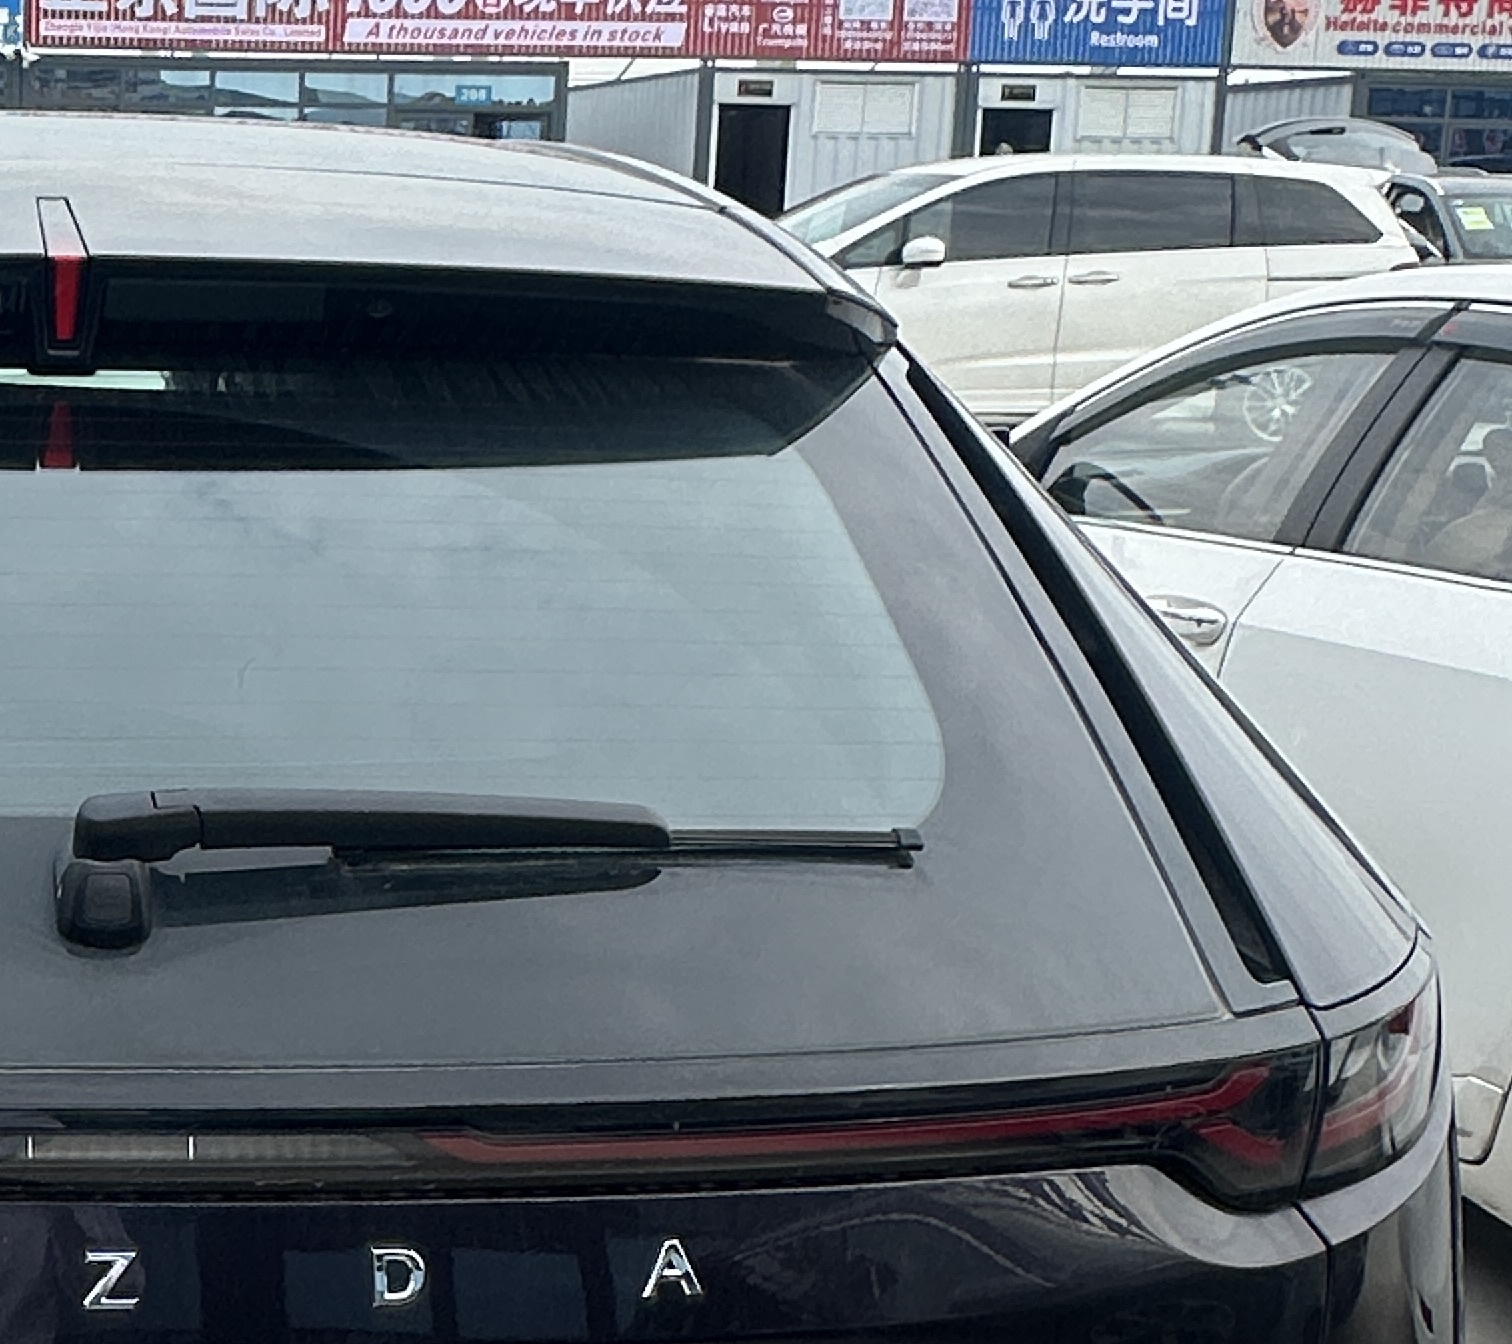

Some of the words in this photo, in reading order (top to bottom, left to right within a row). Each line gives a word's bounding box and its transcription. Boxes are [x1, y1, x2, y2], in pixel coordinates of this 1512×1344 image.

[365, 21, 382, 40] A
[387, 21, 489, 41] thousand
[493, 23, 578, 42] vehicles
[582, 24, 603, 42] in
[606, 24, 665, 44] stock
[1392, 20, 1504, 36] commercial
[1090, 30, 1160, 48] Restroom
